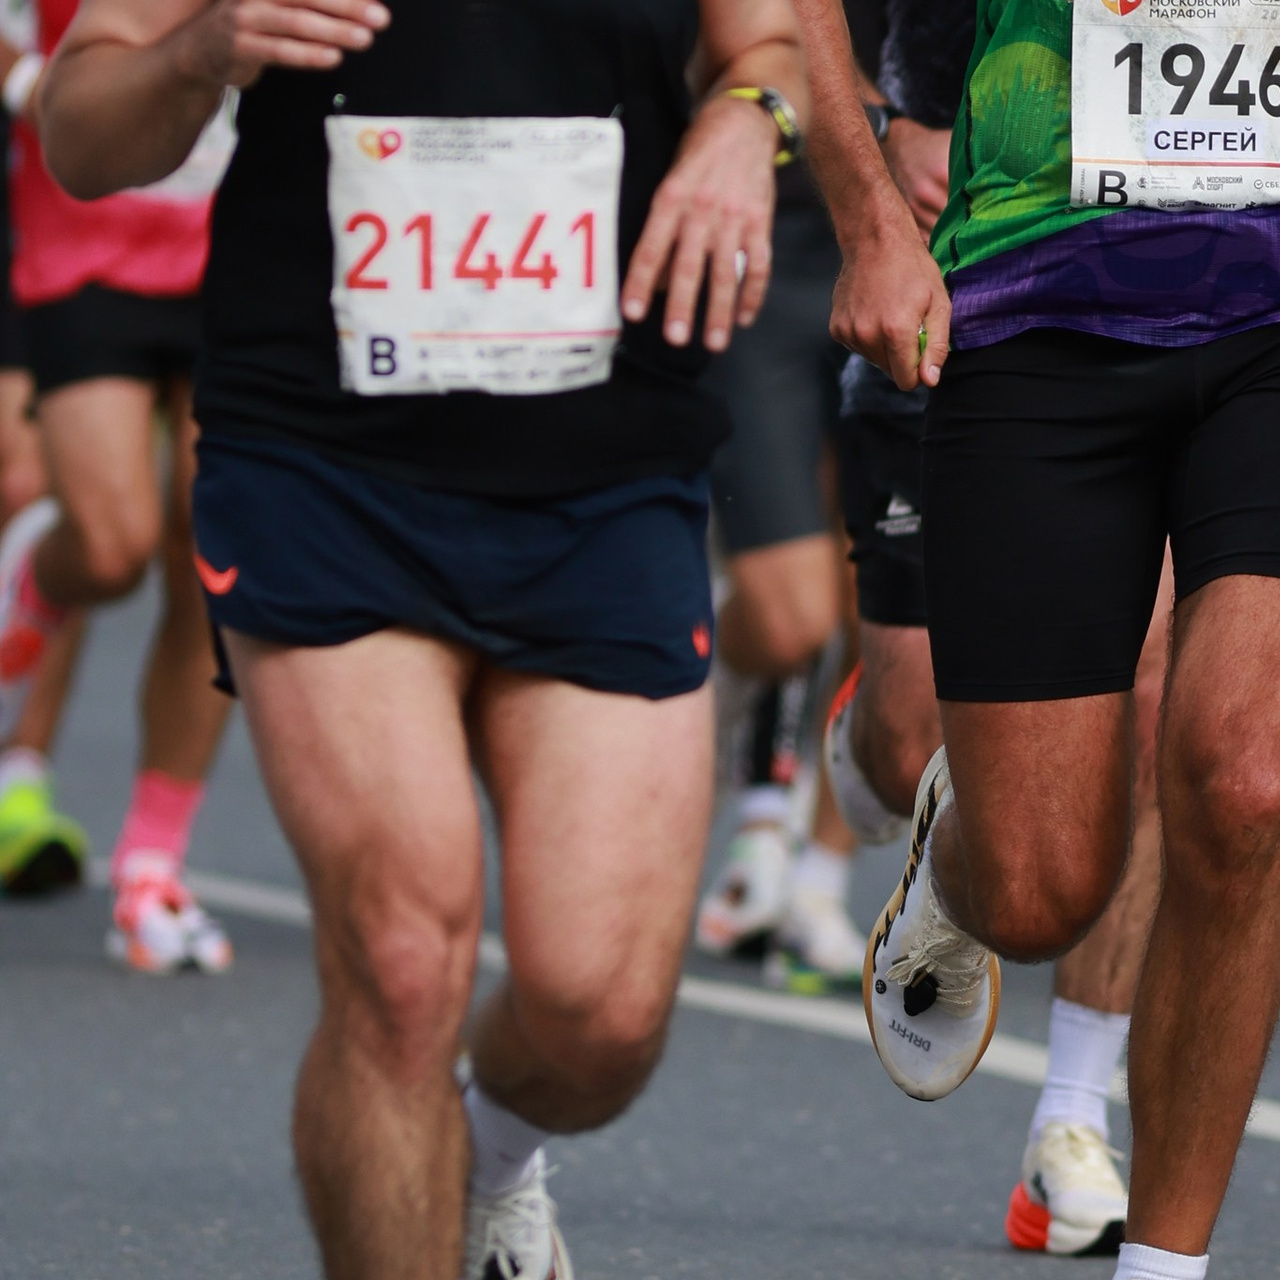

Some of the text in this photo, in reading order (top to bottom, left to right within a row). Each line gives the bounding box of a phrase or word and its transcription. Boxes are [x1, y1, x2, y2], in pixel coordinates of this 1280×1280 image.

[1149, 8, 1217, 19] МАРАФОН
[1153, 127, 1257, 152] СЕРГЕЙ
[344, 212, 594, 290] 21441
[888, 1019, 931, 1052] DRI-FIT
